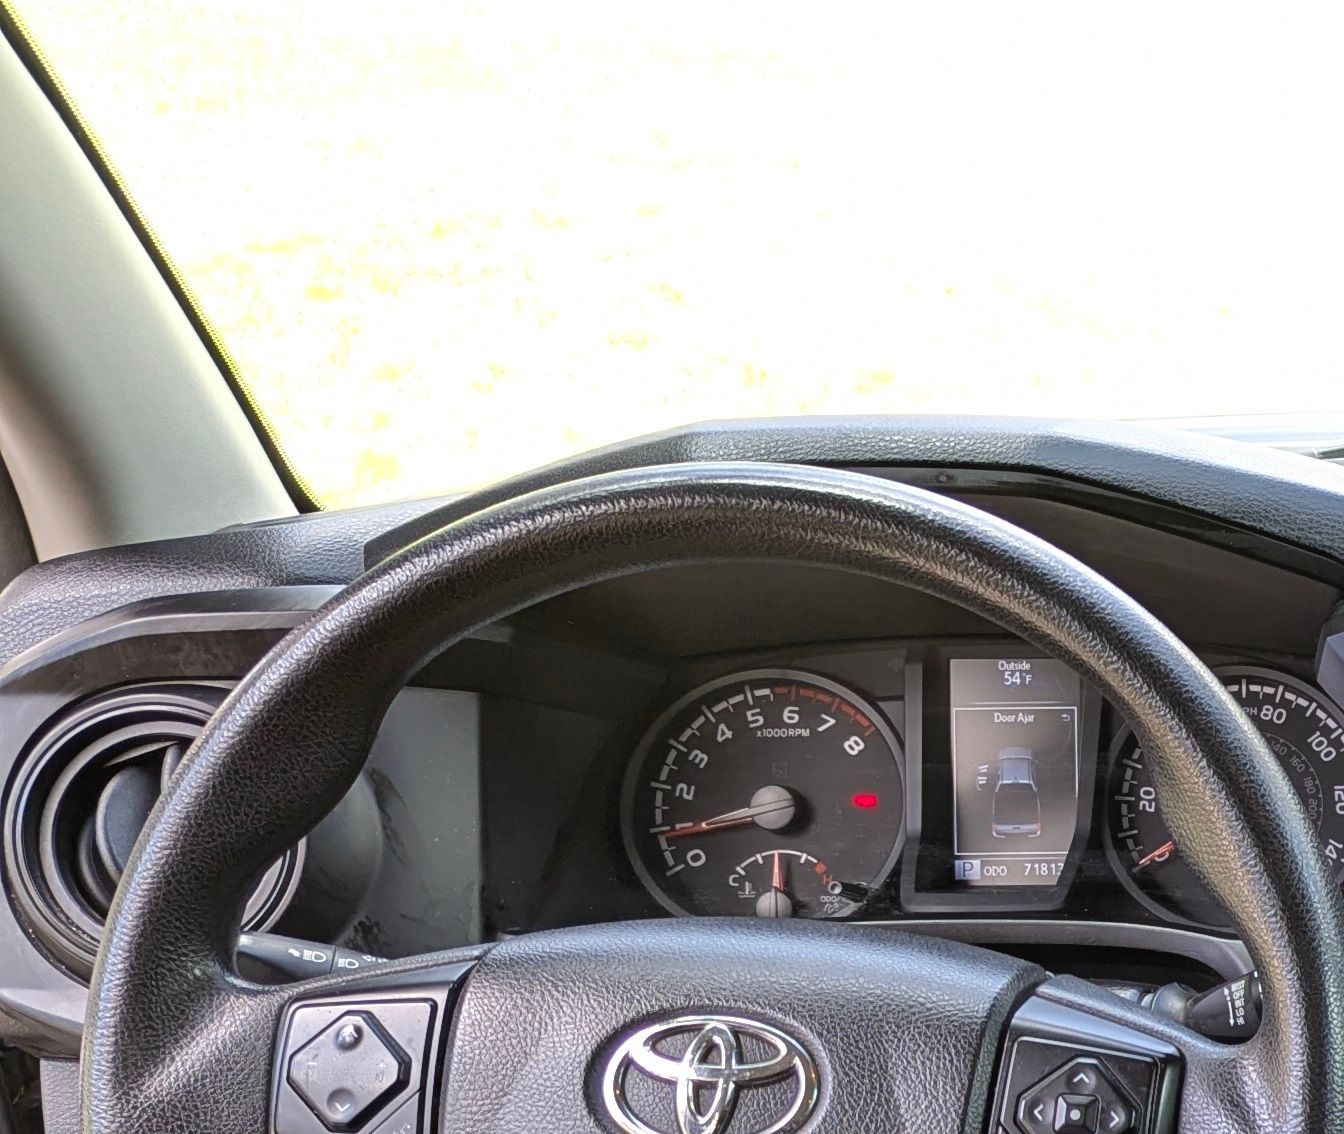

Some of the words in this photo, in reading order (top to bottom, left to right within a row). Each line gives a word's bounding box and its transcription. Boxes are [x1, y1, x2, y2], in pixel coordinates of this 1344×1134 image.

[998, 660, 1032, 671] Outside
[746, 708, 765, 728] 5
[782, 706, 800, 724] 6
[816, 713, 837, 732] 7
[994, 713, 1016, 723] Door
[1017, 713, 1034, 724] Ajar
[1260, 705, 1287, 725] 80
[717, 723, 733, 743] 4
[843, 735, 865, 756] 8
[1307, 730, 1337, 762] 100
[688, 749, 709, 769] 3
[1289, 755, 1306, 773] 160
[675, 782, 695, 801] 2
[1303, 776, 1316, 795] 180
[1139, 786, 1156, 813] 20
[686, 849, 706, 867] 0
[962, 861, 974, 878] P
[983, 866, 1008, 876] ODO
[728, 874, 740, 886] C
